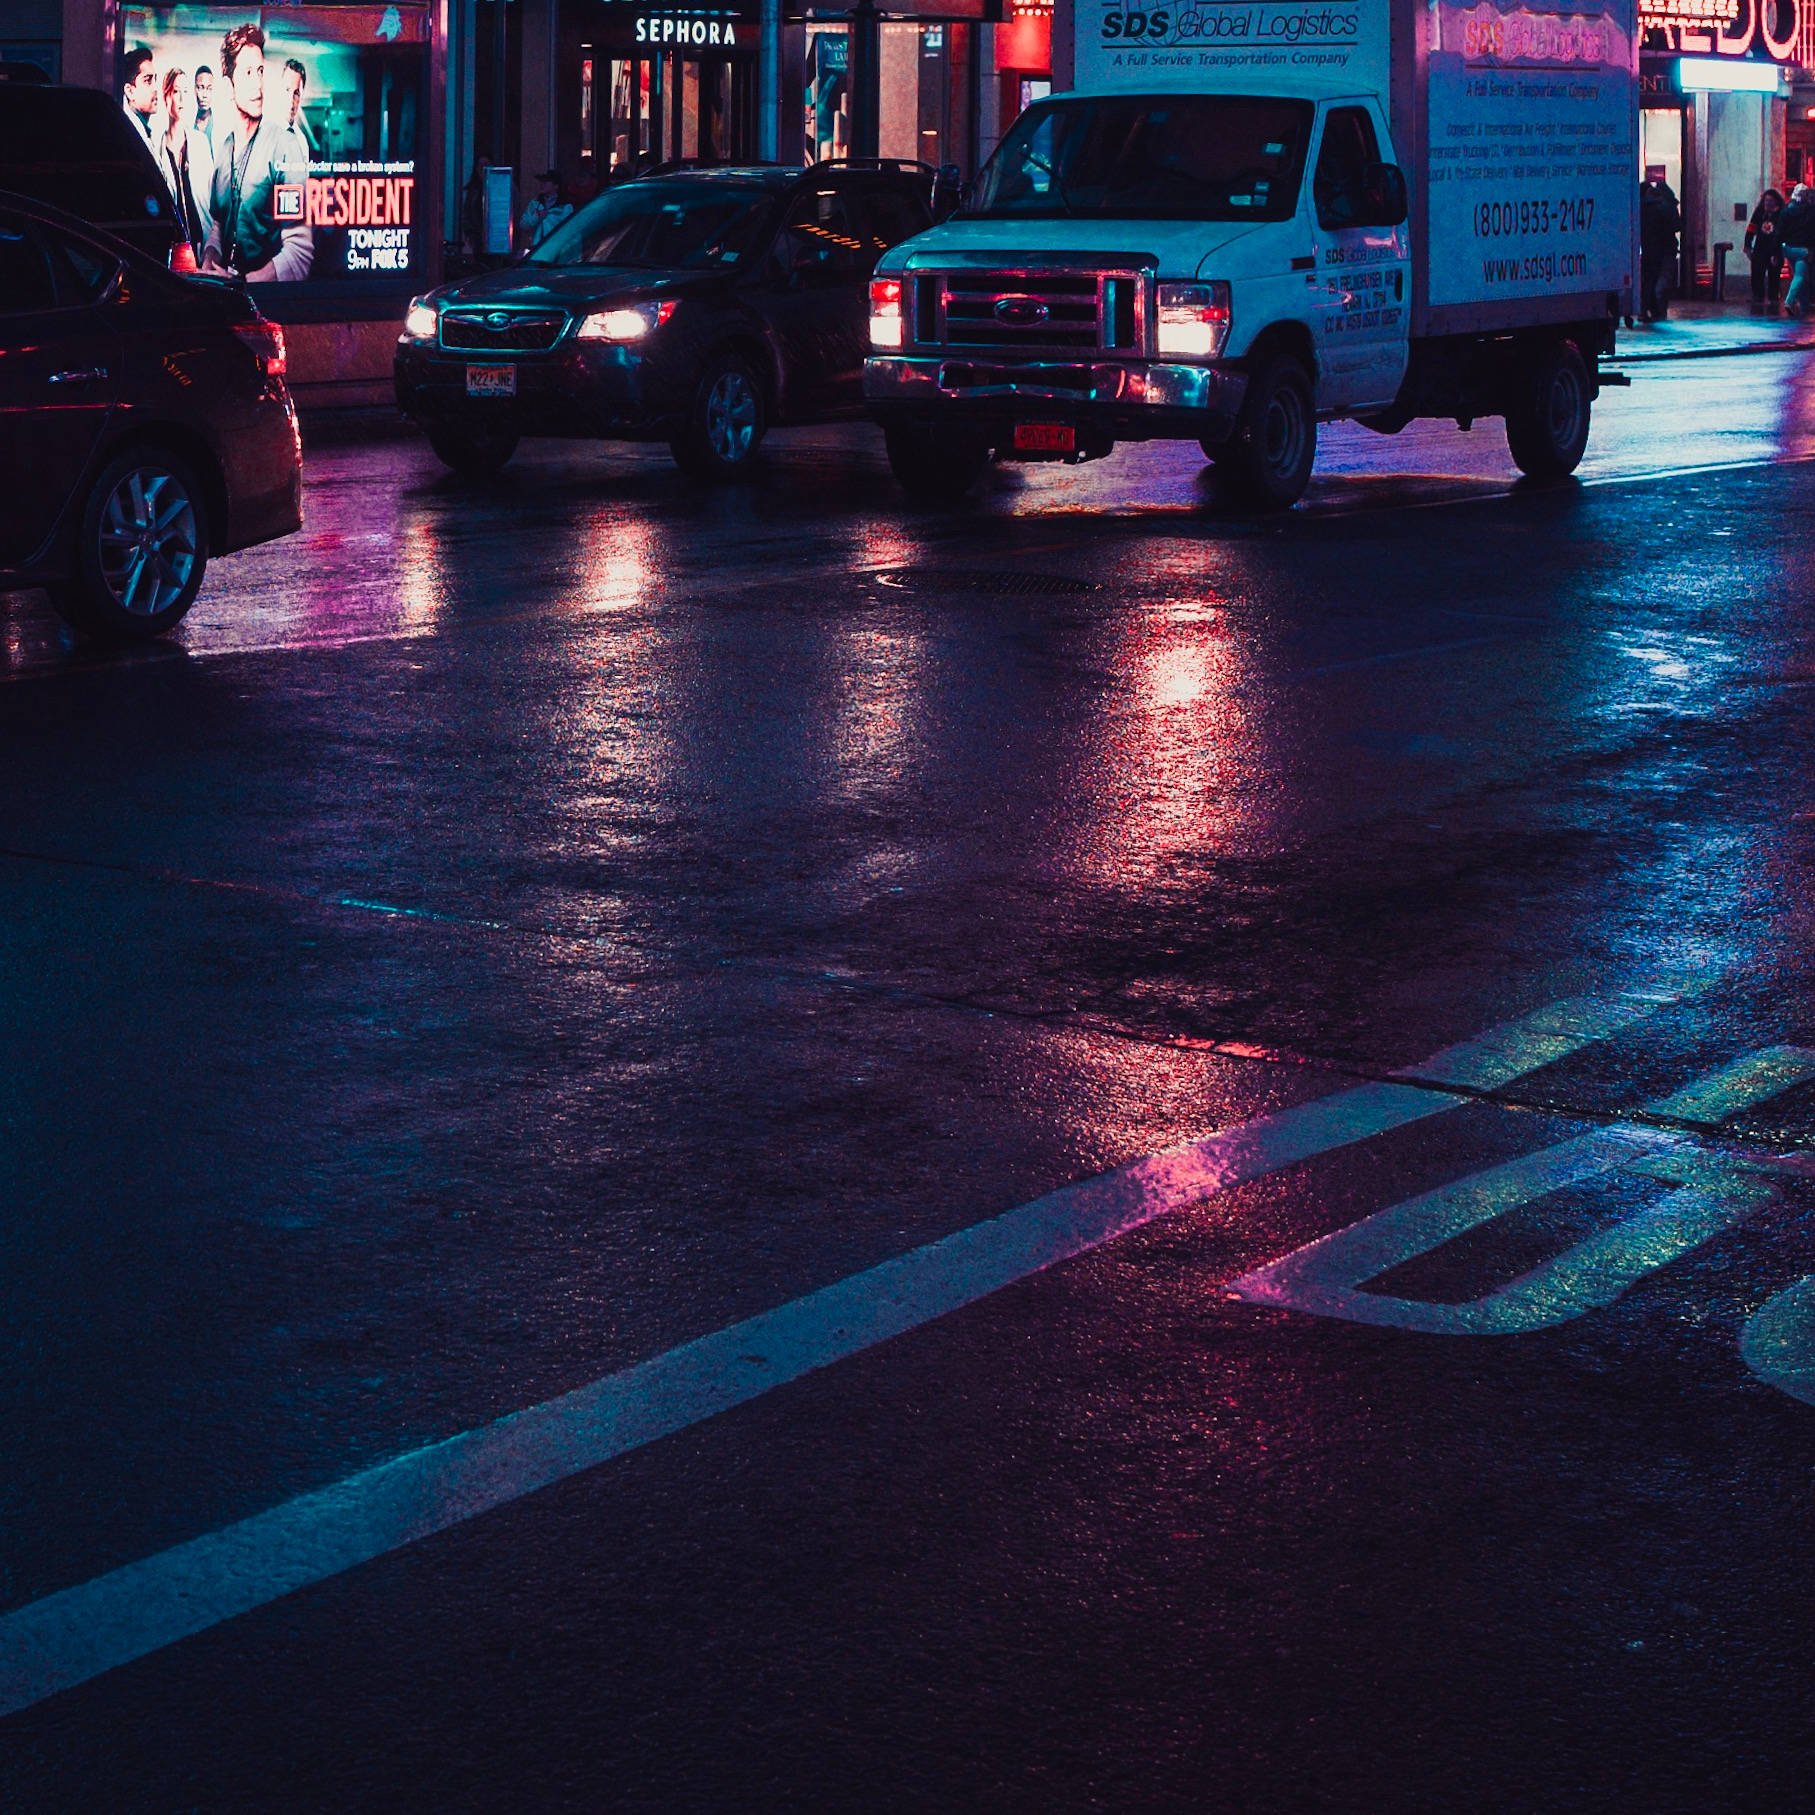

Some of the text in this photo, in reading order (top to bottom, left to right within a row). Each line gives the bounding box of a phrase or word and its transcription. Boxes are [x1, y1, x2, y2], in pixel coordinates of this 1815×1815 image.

[635, 18, 736, 46] SEPHORA
[1102, 8, 1358, 42] SDS Global Logistics
[1465, 19, 1504, 55] SDS
[1113, 52, 1349, 69] A Full Service Transportation Company
[278, 177, 414, 226] THE RESIDENT
[1474, 198, 1595, 237] (800)933-2147
[347, 229, 410, 249] TONIGHT
[371, 249, 397, 269] FOX
[1483, 253, 1588, 283] www.sdsgl.com
